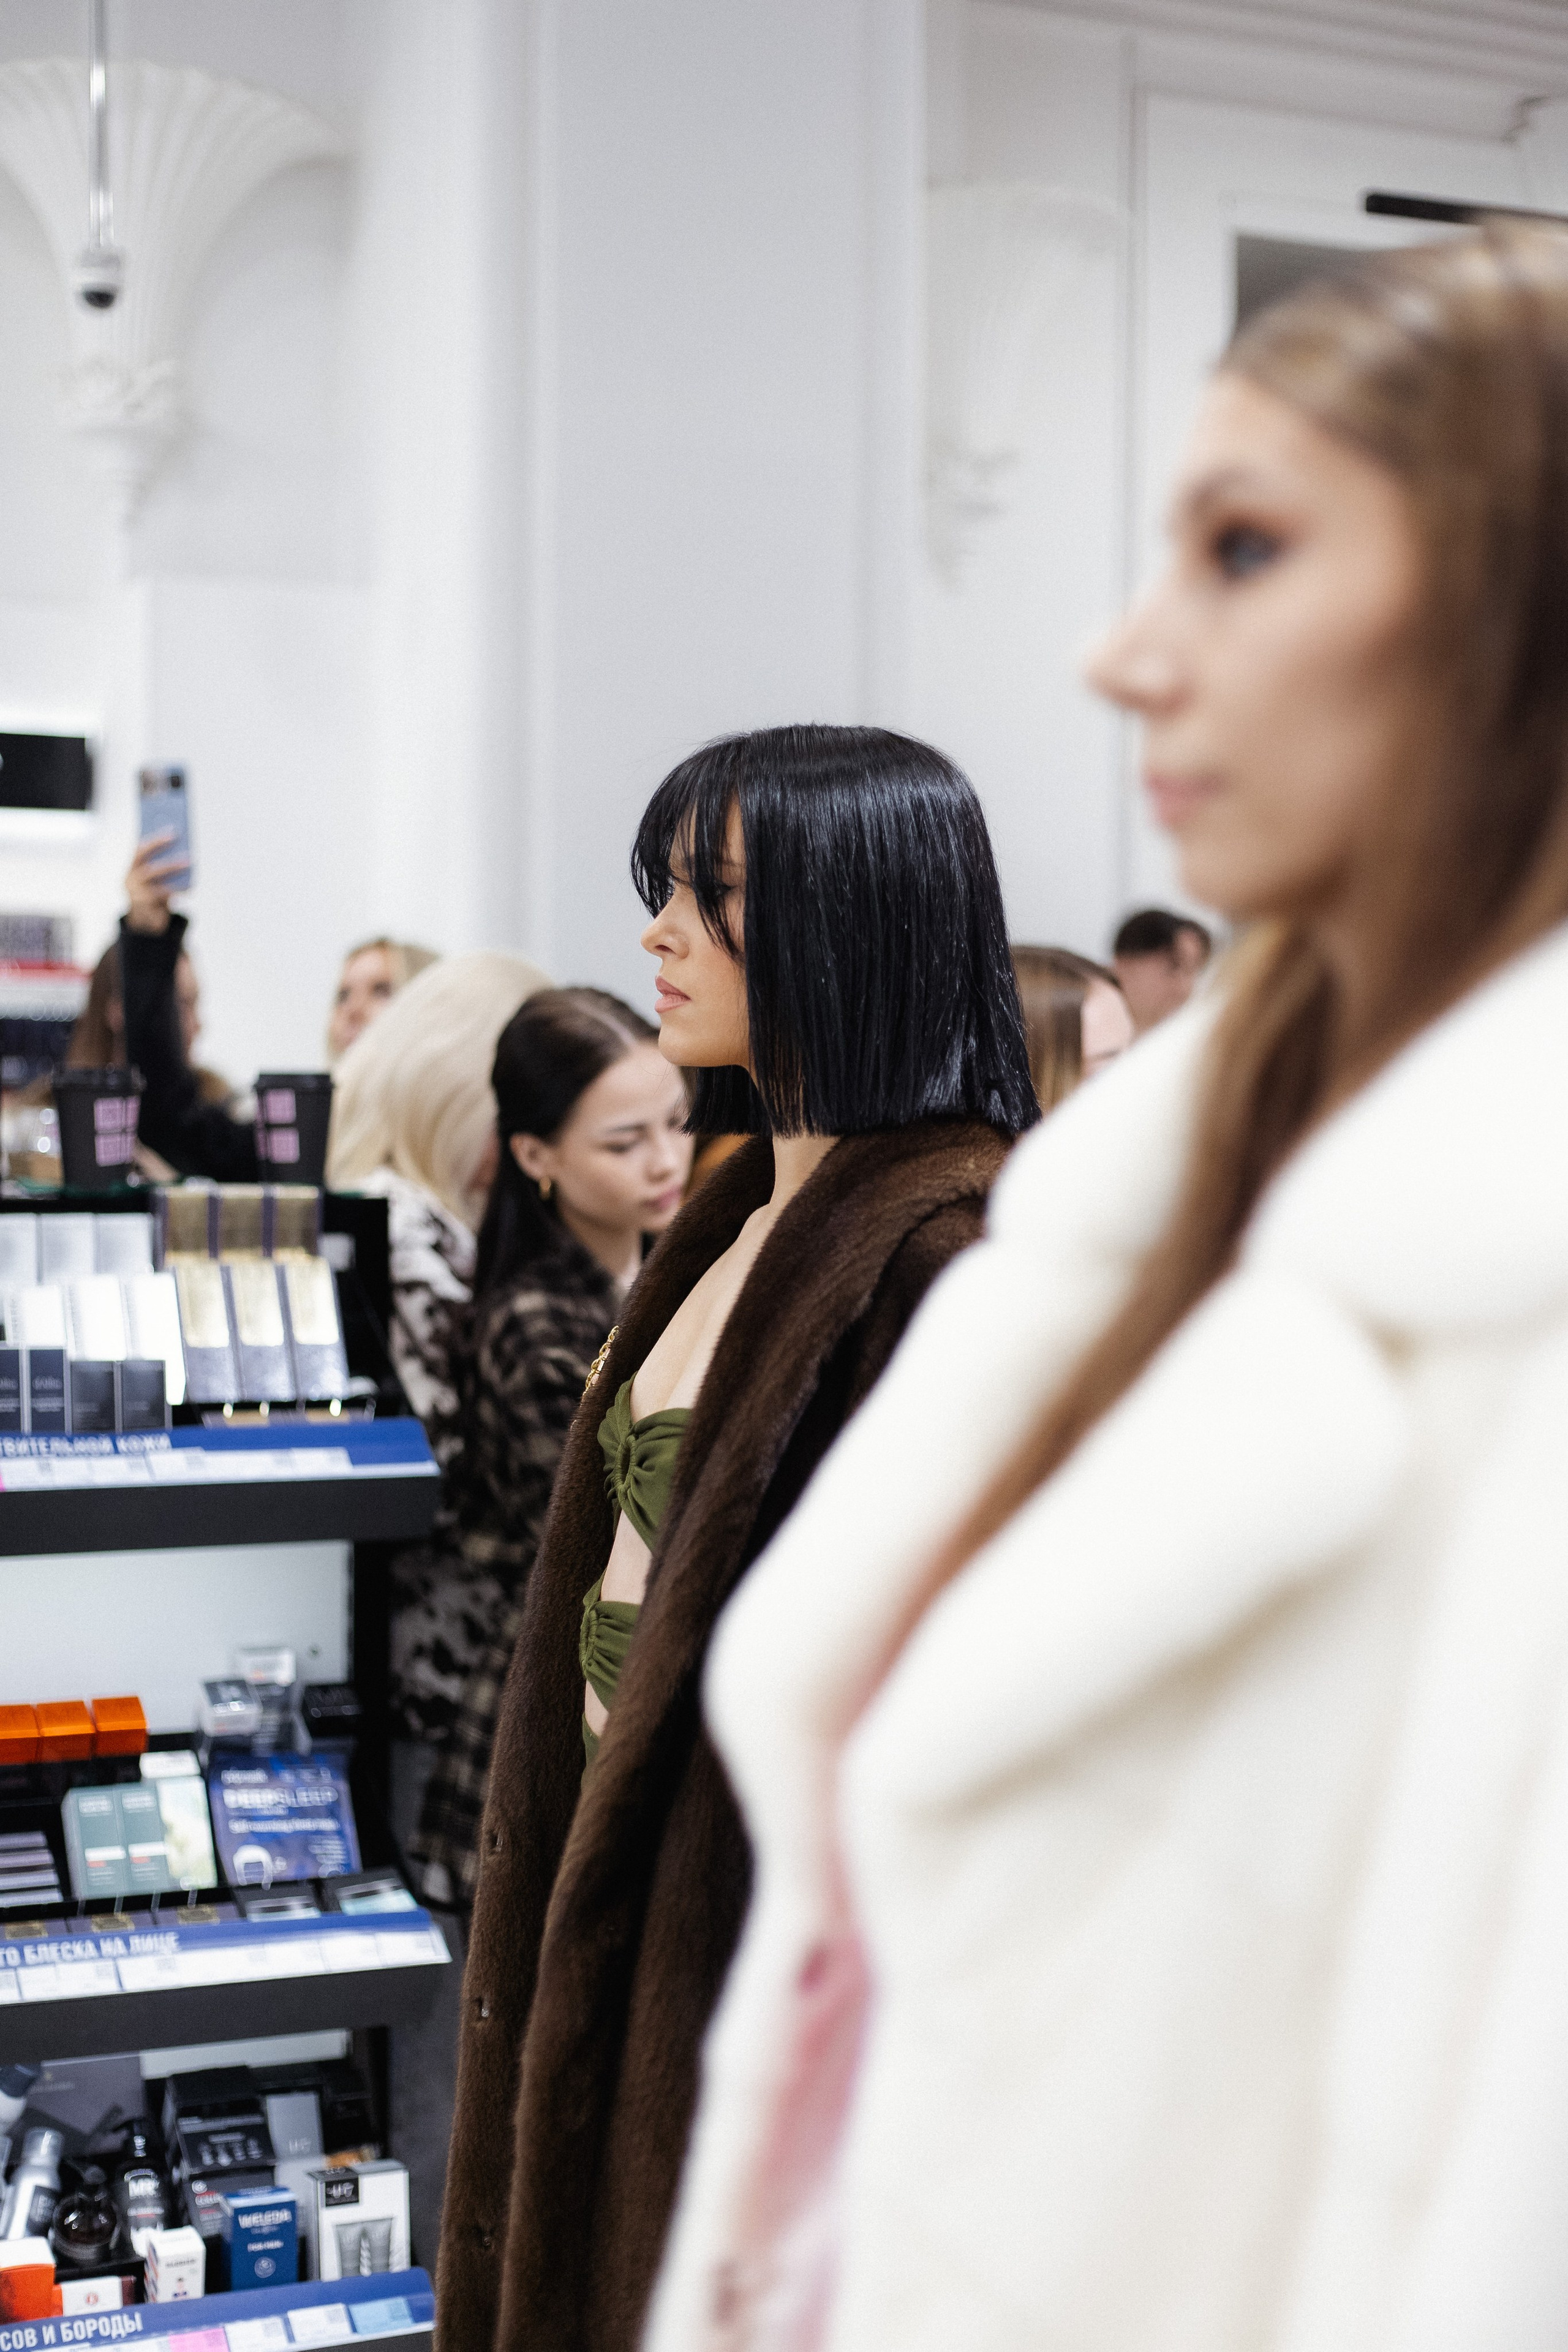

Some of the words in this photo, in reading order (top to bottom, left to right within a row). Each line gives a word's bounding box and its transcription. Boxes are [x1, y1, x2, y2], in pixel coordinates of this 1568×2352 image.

[0, 1433, 115, 1457] ВИТЕЛЬНОЙ
[23, 1939, 99, 1965] БЛЕСКА
[99, 1936, 128, 1958] НА
[129, 1931, 179, 1956] ЛИЦЕ
[0, 2327, 38, 2351] СОВ
[42, 2323, 56, 2345] И
[60, 2311, 143, 2343] БОРОДЫ
